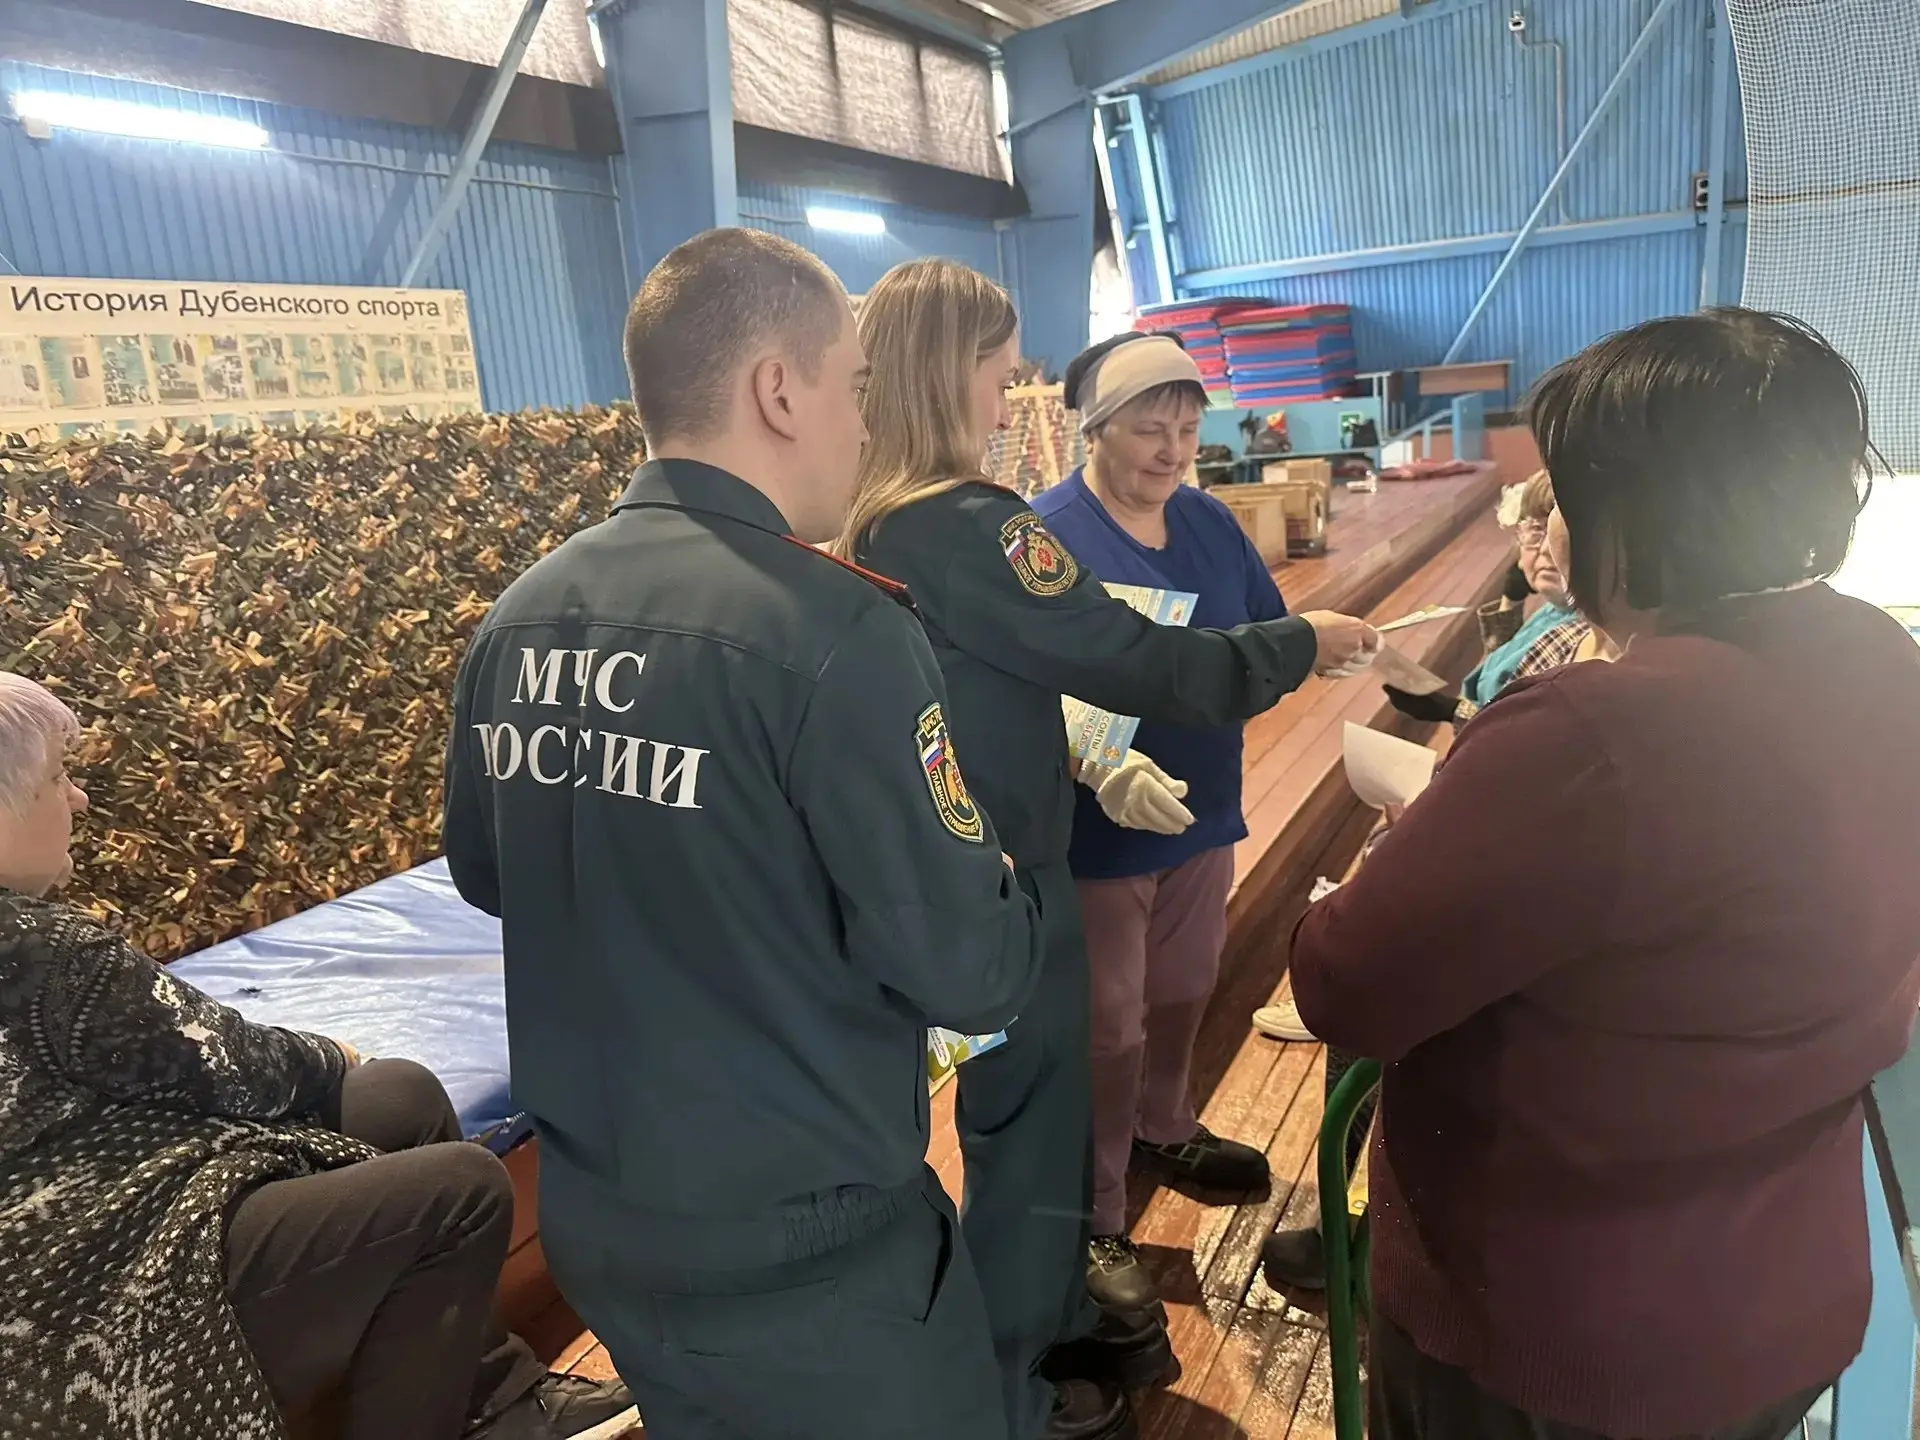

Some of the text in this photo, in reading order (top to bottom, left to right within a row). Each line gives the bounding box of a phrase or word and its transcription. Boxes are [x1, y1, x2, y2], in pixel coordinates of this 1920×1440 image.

[10, 286, 441, 320] История Дубенского спорта
[511, 647, 647, 713] МЧС
[931, 770, 946, 809] ГЛАВНОЕ
